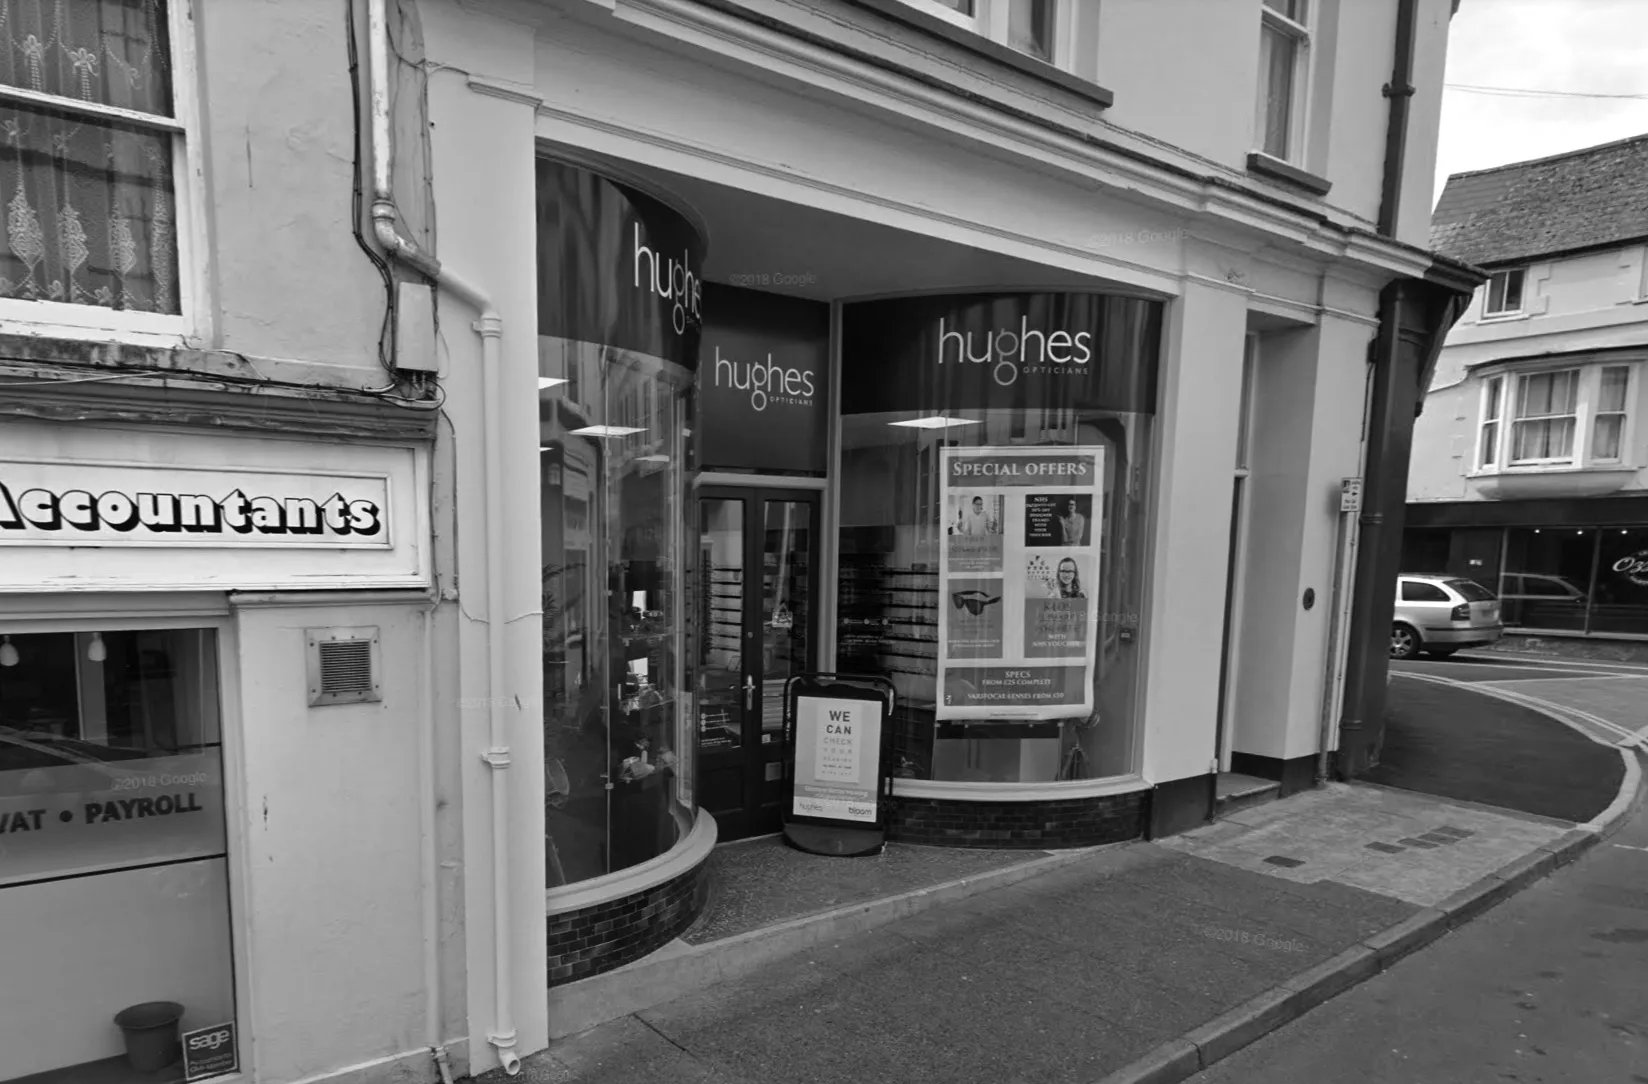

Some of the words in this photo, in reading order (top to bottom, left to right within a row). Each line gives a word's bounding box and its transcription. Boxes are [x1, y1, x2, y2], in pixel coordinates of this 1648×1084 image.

[938, 315, 1091, 386] hughes
[1023, 366, 1089, 375] OPTICIANS
[715, 346, 815, 411] hughes
[769, 395, 813, 406] OPTICIANS
[953, 461, 1020, 476] SPECIAL
[1025, 462, 1087, 476] OFFERS
[1005, 671, 1031, 679] SPECS
[829, 709, 851, 722] WE
[826, 724, 852, 735] CAN
[823, 737, 852, 745] CHECK
[84, 792, 203, 824] PAYROLL
[189, 1029, 230, 1050] sage
